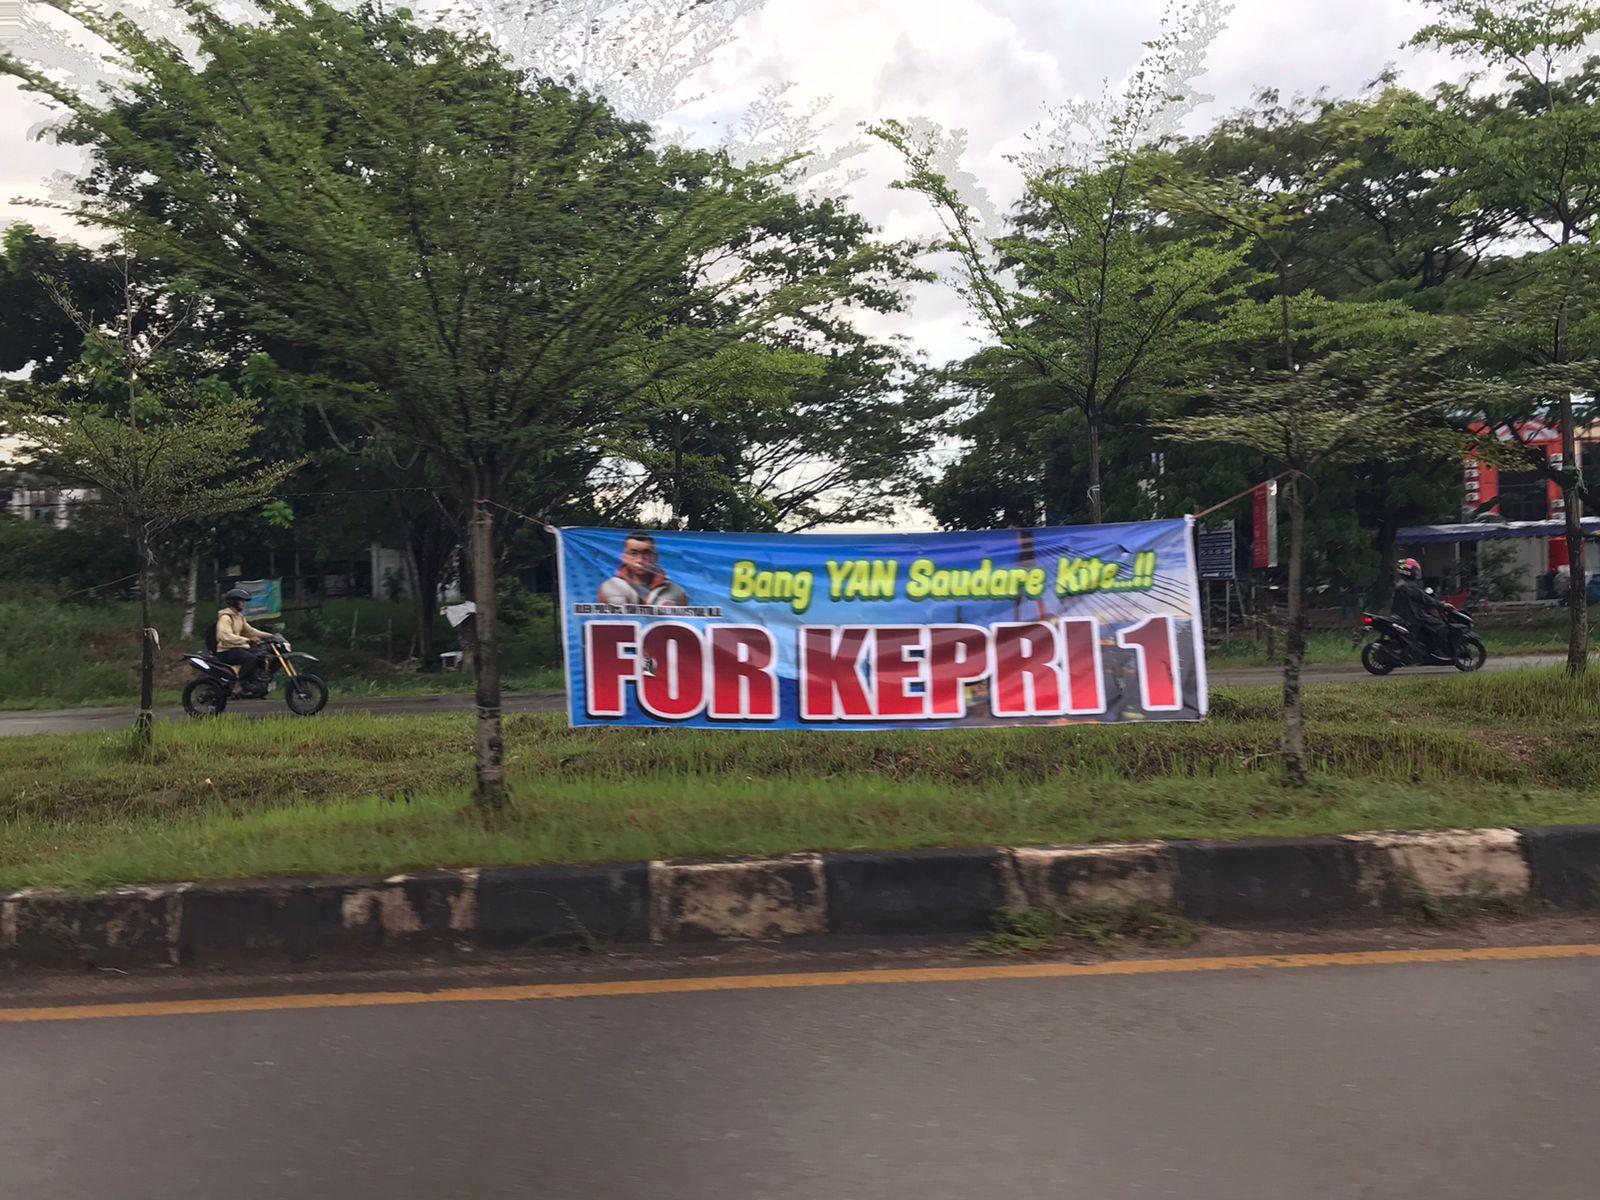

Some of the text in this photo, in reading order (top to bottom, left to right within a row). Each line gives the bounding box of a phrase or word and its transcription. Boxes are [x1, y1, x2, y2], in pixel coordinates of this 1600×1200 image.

[731, 560, 814, 612] Bang
[826, 559, 898, 600] YAN
[906, 558, 1046, 599] Saudare
[585, 612, 1182, 720] FOR KEPRI 1
